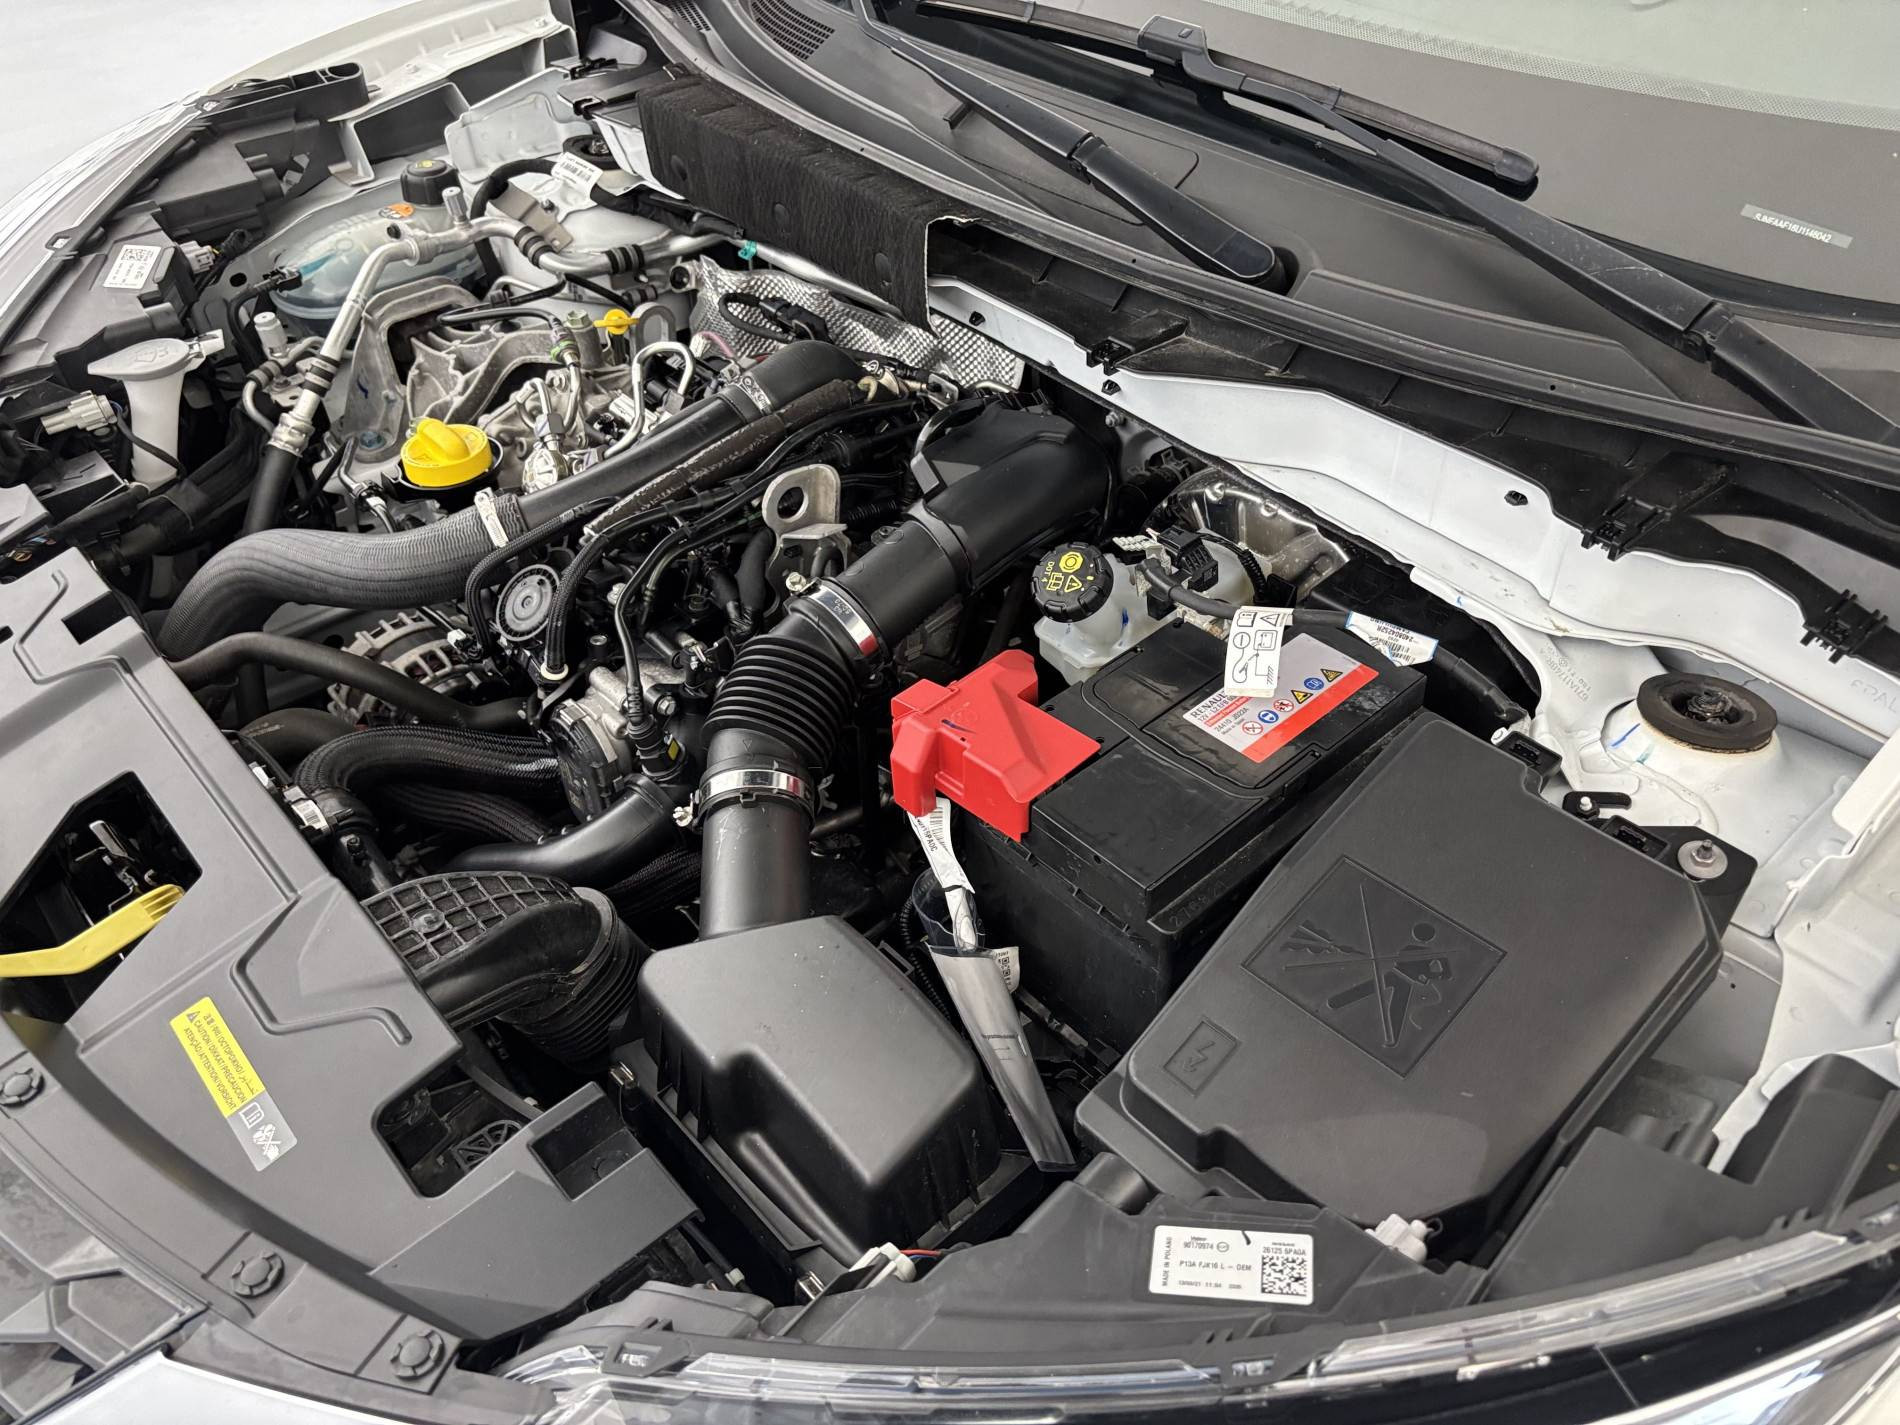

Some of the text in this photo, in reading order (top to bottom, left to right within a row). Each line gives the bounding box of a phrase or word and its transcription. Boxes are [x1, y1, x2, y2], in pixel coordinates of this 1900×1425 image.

[1044, 561, 1055, 576] DOT
[1190, 691, 1228, 718] RENAUL
[1162, 1237, 1172, 1286] MADE IN POLAND
[1179, 1260, 1196, 1268] P13A
